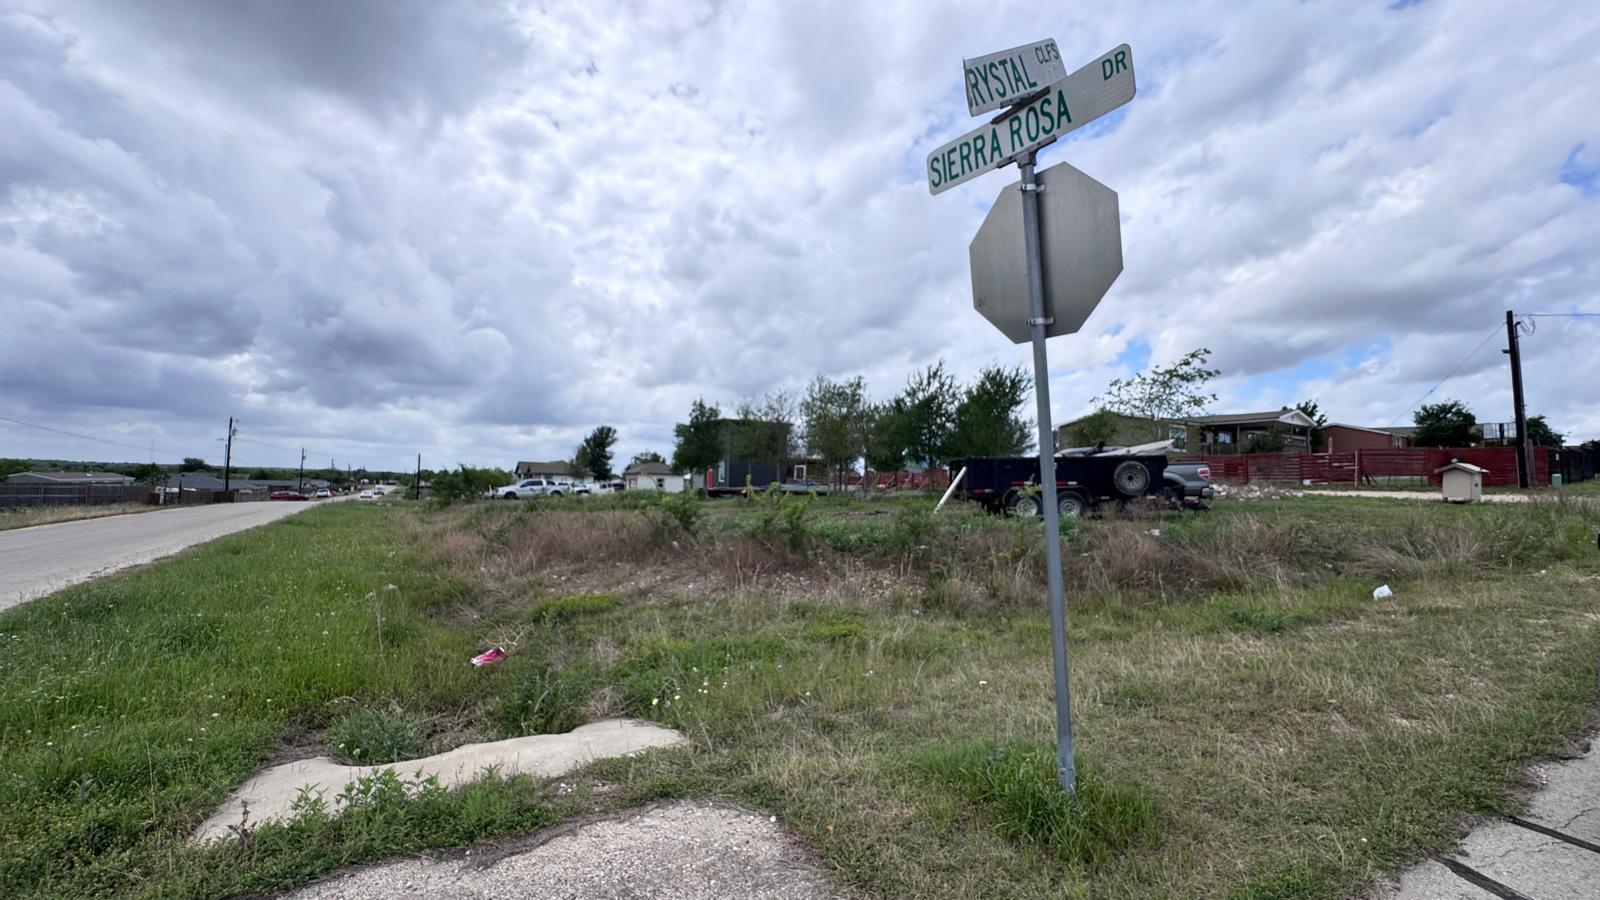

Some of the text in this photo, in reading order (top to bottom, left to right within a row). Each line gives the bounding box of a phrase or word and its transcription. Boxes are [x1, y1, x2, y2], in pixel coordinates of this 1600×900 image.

[930, 50, 1128, 188] SIERRA ROSA DR
[966, 42, 1060, 107] RYSTAL CLFS
